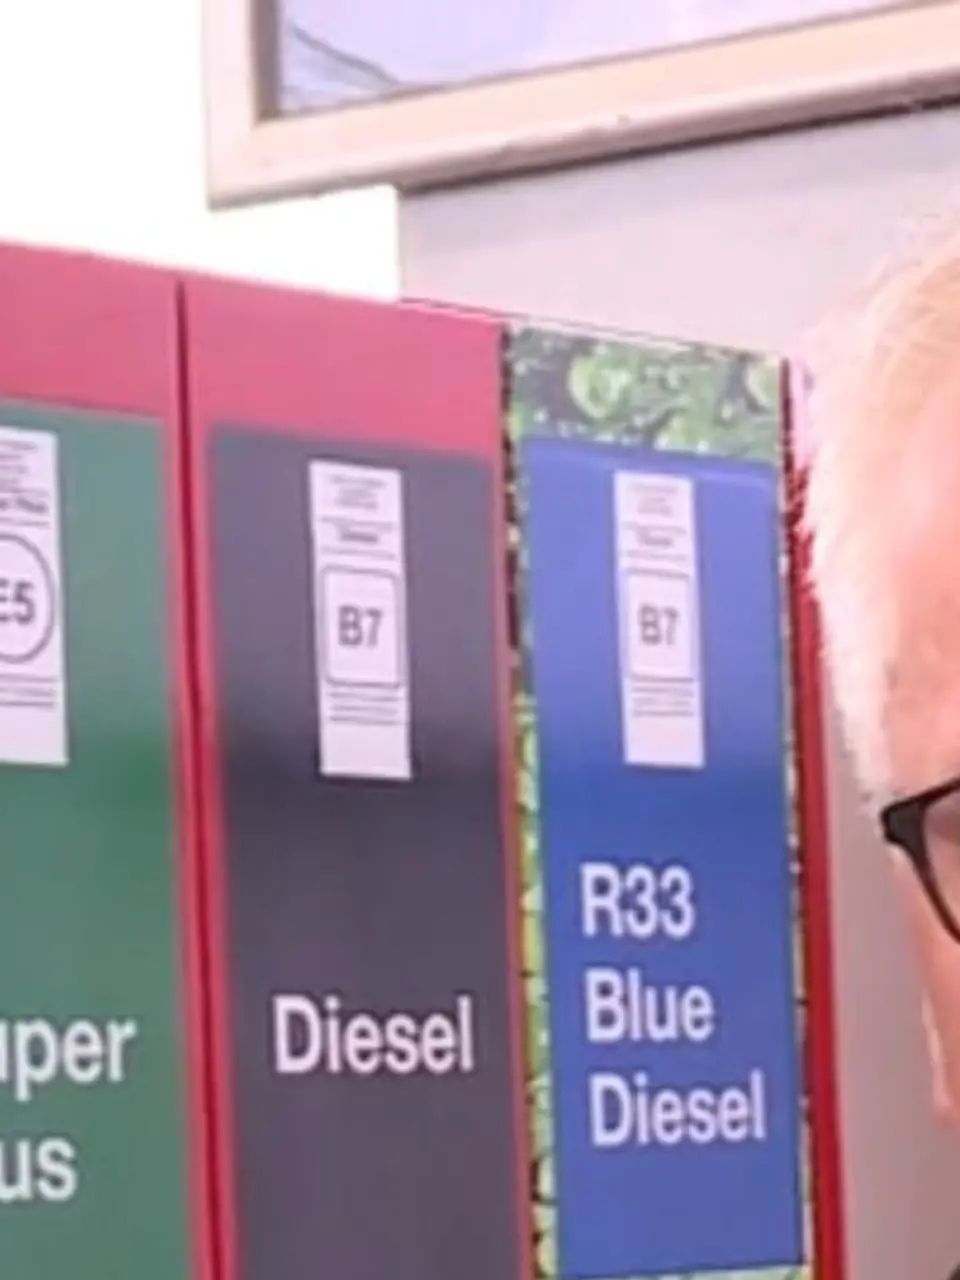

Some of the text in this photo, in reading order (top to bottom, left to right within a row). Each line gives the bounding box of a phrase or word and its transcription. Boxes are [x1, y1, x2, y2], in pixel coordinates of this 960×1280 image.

[338, 604, 384, 648] B7
[638, 604, 681, 647] B7
[580, 862, 695, 939] R33
[272, 994, 474, 1074] Diesel
[585, 968, 715, 1044] Blue
[0, 1019, 138, 1102] per
[589, 1069, 766, 1146] Diesel
